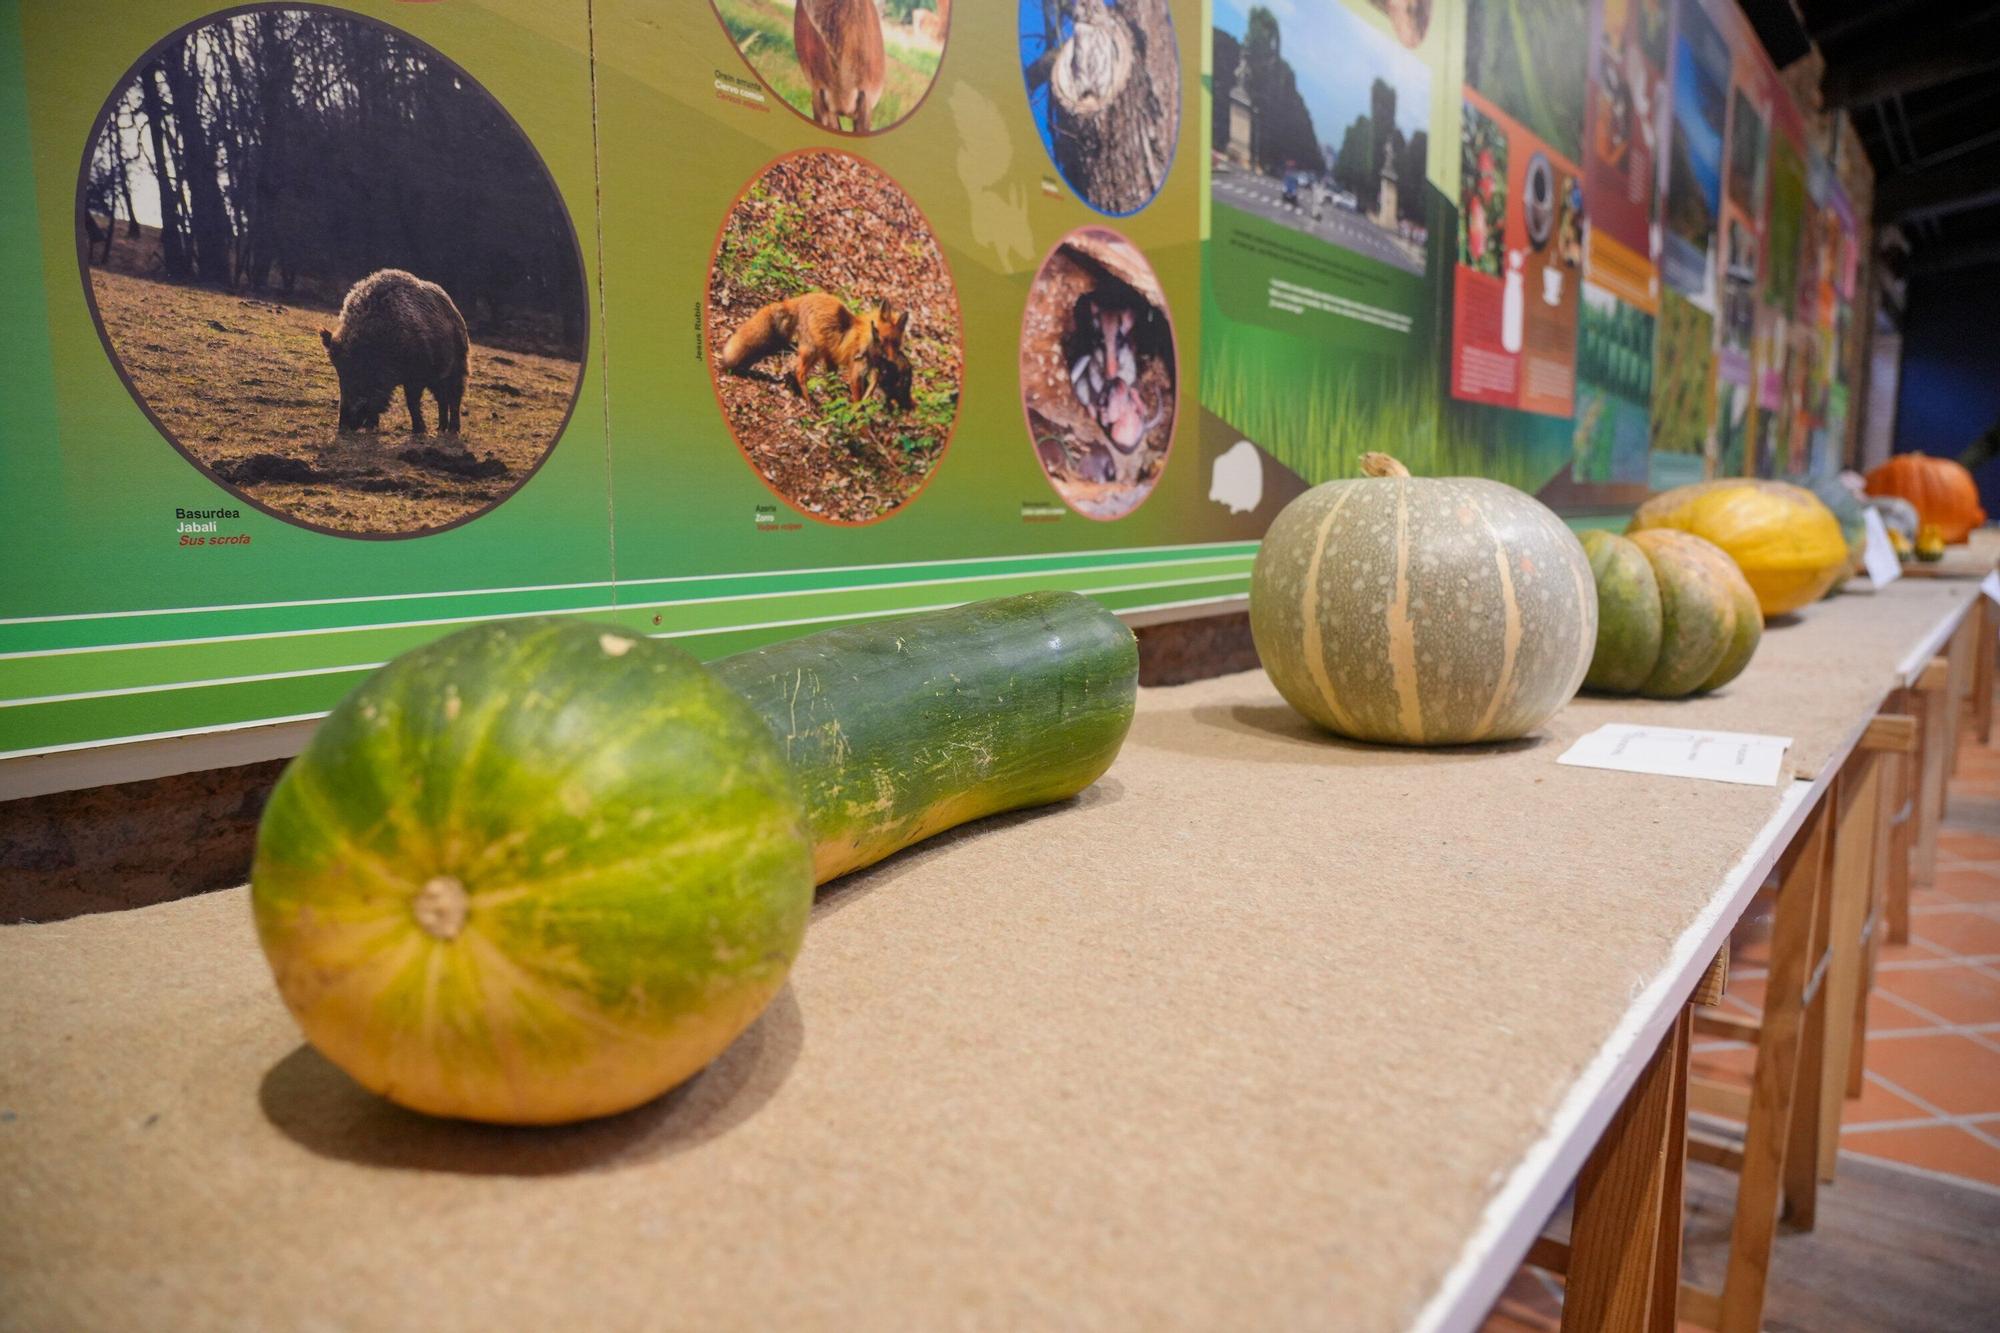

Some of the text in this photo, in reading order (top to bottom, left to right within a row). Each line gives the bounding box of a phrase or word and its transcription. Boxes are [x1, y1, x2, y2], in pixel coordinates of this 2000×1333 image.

[714, 79, 739, 95] Ciervo
[176, 508, 240, 519] Basurdea
[179, 534, 252, 546] Sus scrofa
